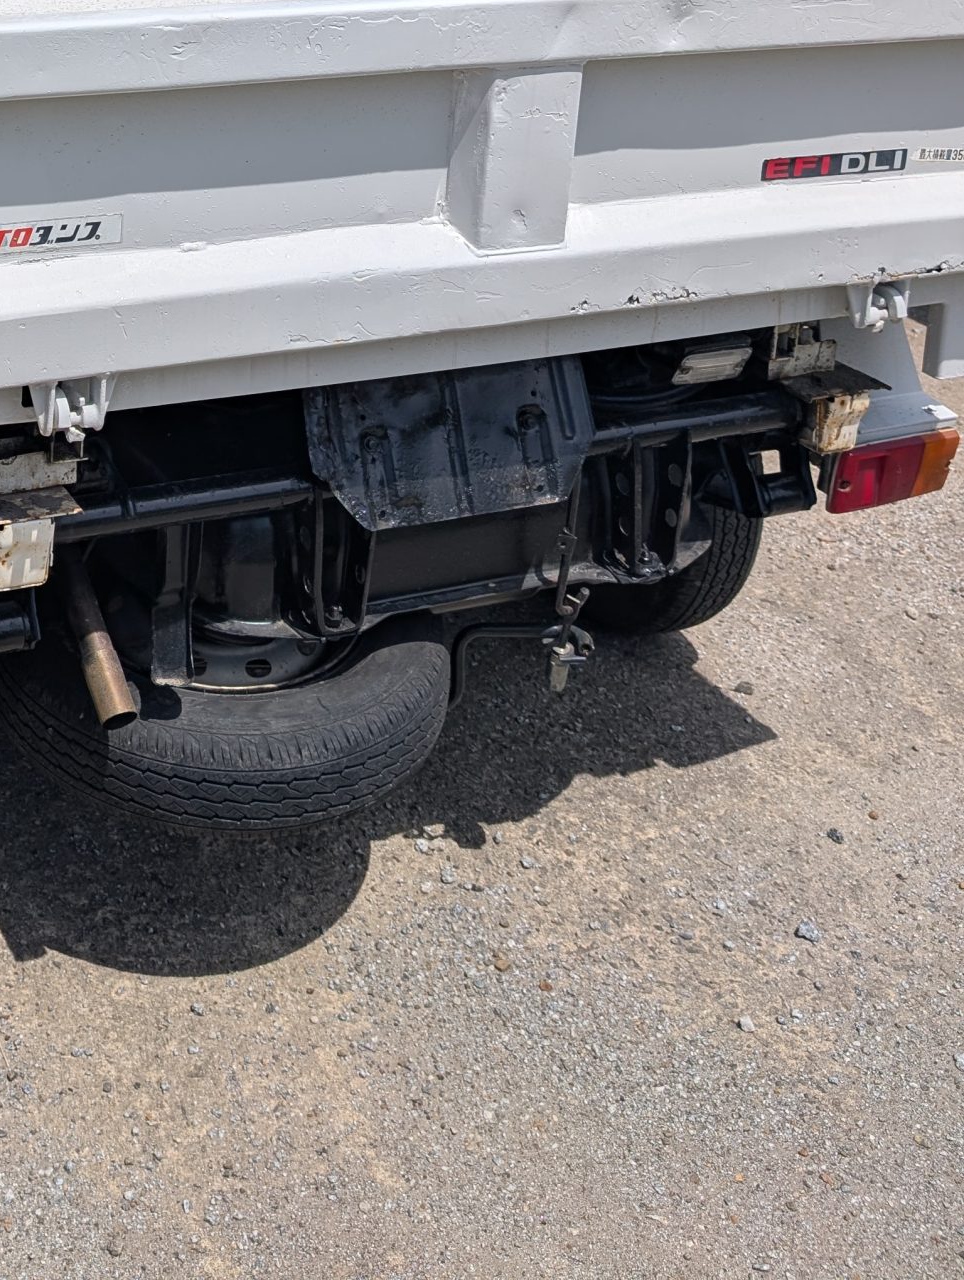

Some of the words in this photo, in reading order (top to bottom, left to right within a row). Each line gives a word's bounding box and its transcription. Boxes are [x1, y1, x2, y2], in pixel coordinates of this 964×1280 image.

[765, 154, 831, 179] EFI
[840, 150, 903, 174] DLI
[918, 148, 964, 161] 最大積載量35
